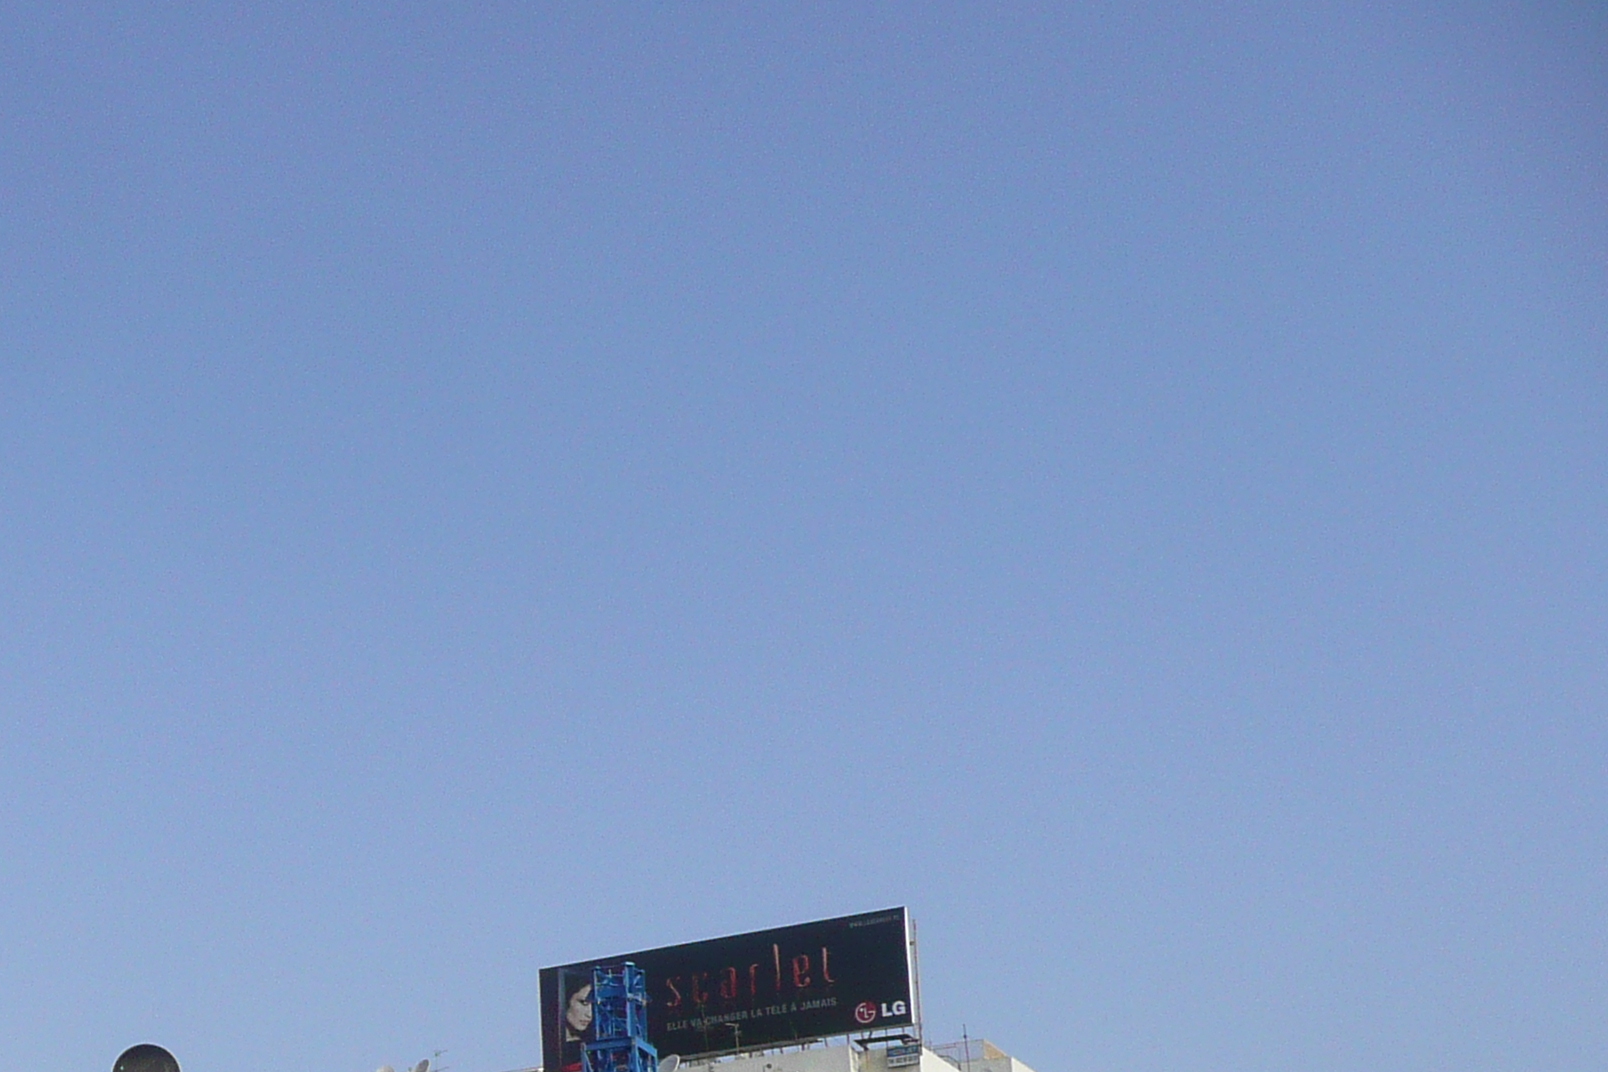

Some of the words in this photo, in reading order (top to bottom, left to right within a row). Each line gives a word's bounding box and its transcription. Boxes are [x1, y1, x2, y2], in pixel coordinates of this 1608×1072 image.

[666, 943, 836, 1007] scarlet
[705, 1010, 748, 1026] CHANGER
[751, 1007, 764, 1018] LA
[800, 997, 837, 1011] JAMAIS
[881, 1001, 906, 1018] LG
